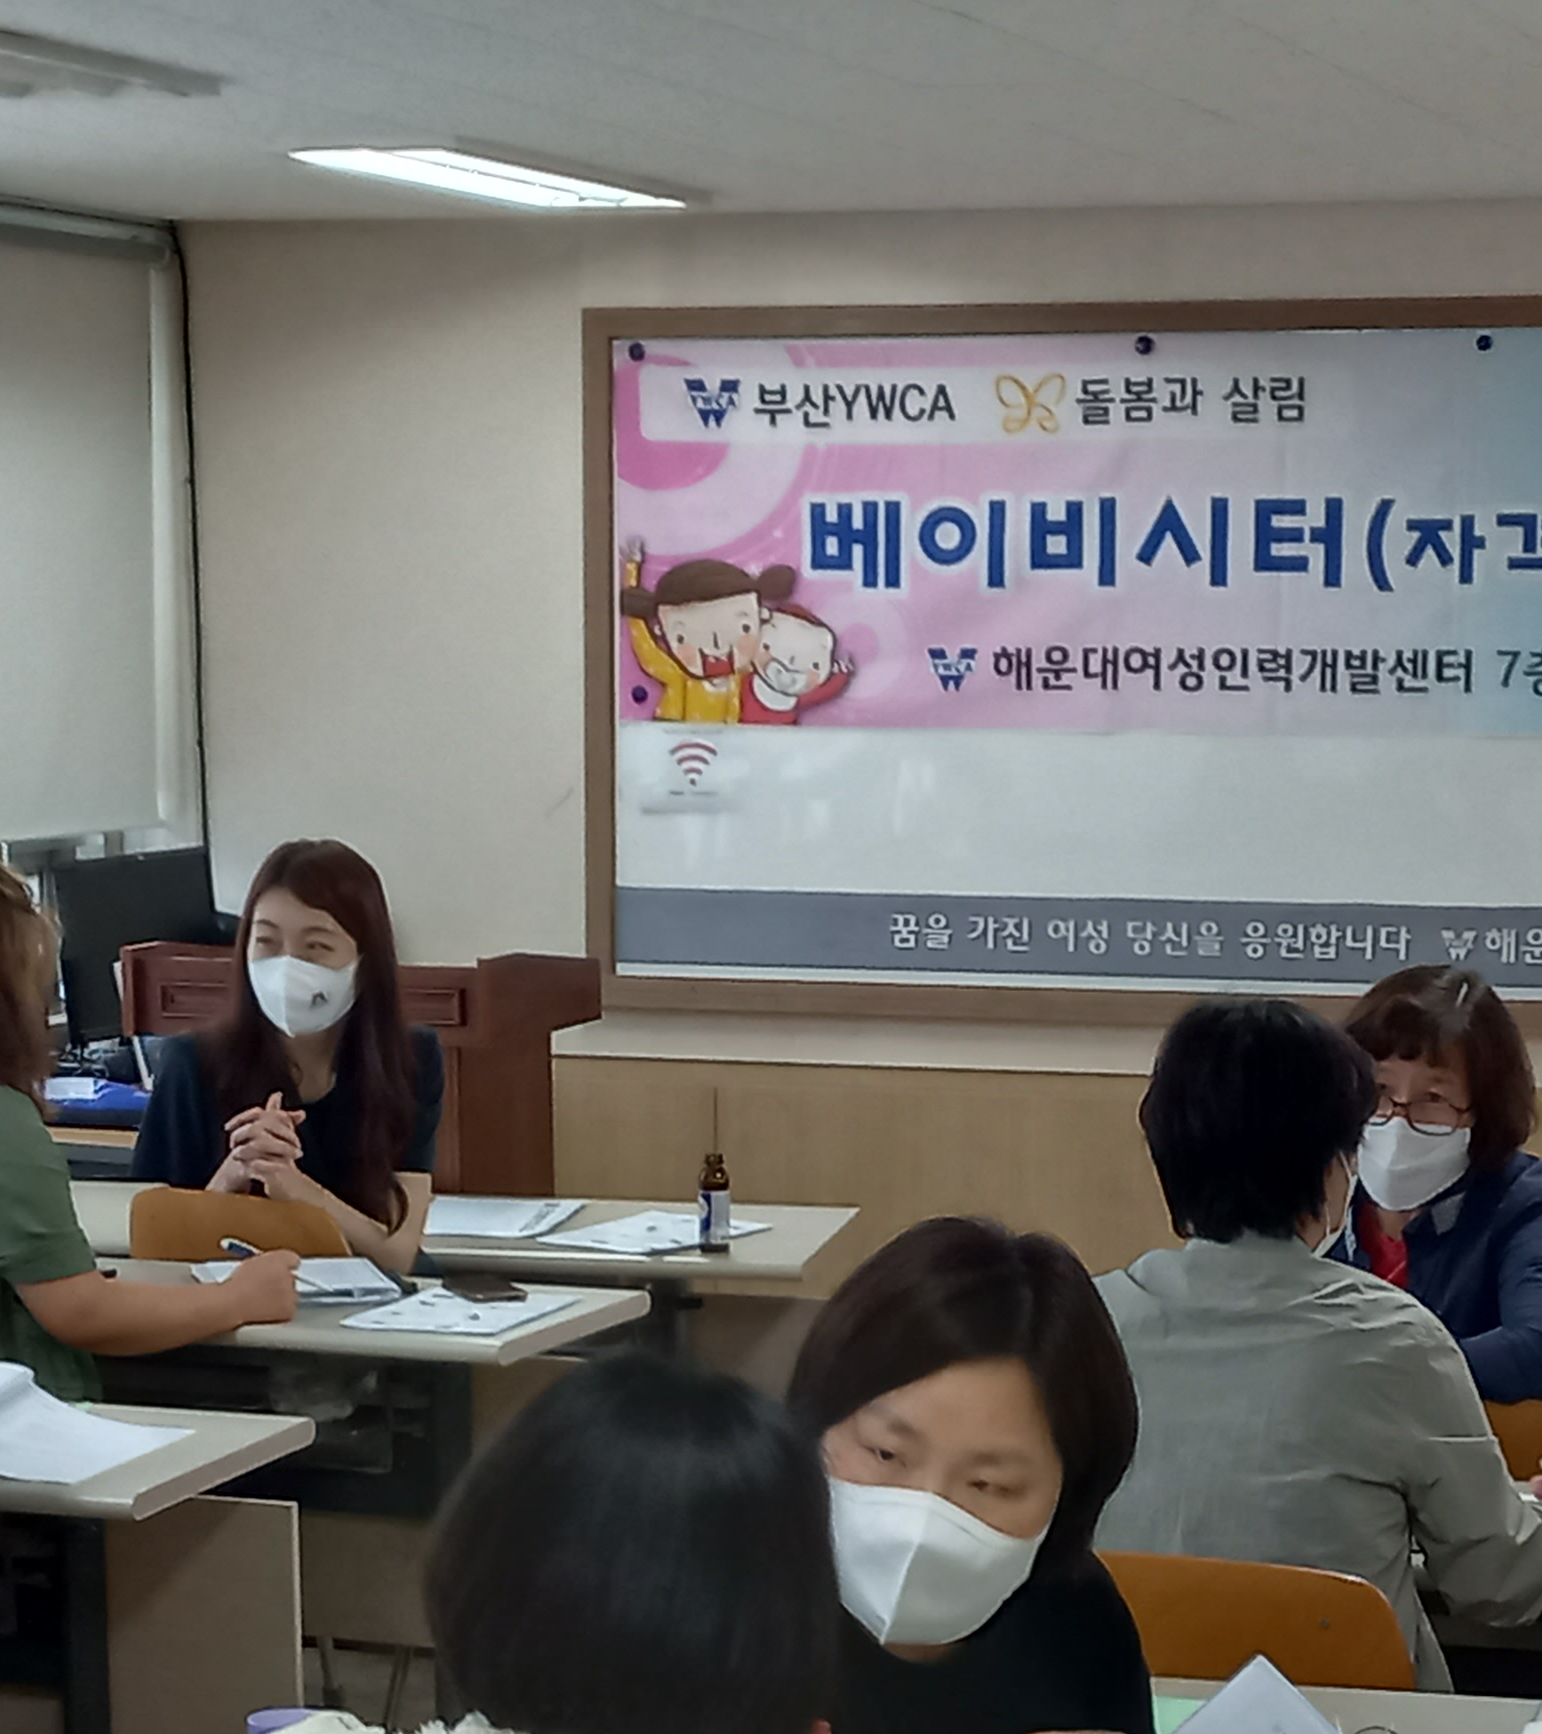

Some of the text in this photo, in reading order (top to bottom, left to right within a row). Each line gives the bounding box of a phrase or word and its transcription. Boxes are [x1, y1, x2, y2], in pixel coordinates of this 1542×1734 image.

[753, 383, 956, 428] 부산YWCA
[1076, 376, 1305, 425] 돌봄과 살림
[993, 645, 1473, 695] 해운대여성인력개발센터
[889, 914, 952, 949] 꿈을
[967, 916, 1029, 951] 가진
[1047, 920, 1108, 954] 여성
[1126, 921, 1220, 956] 당신을
[1240, 922, 1411, 961] 응원합니다
